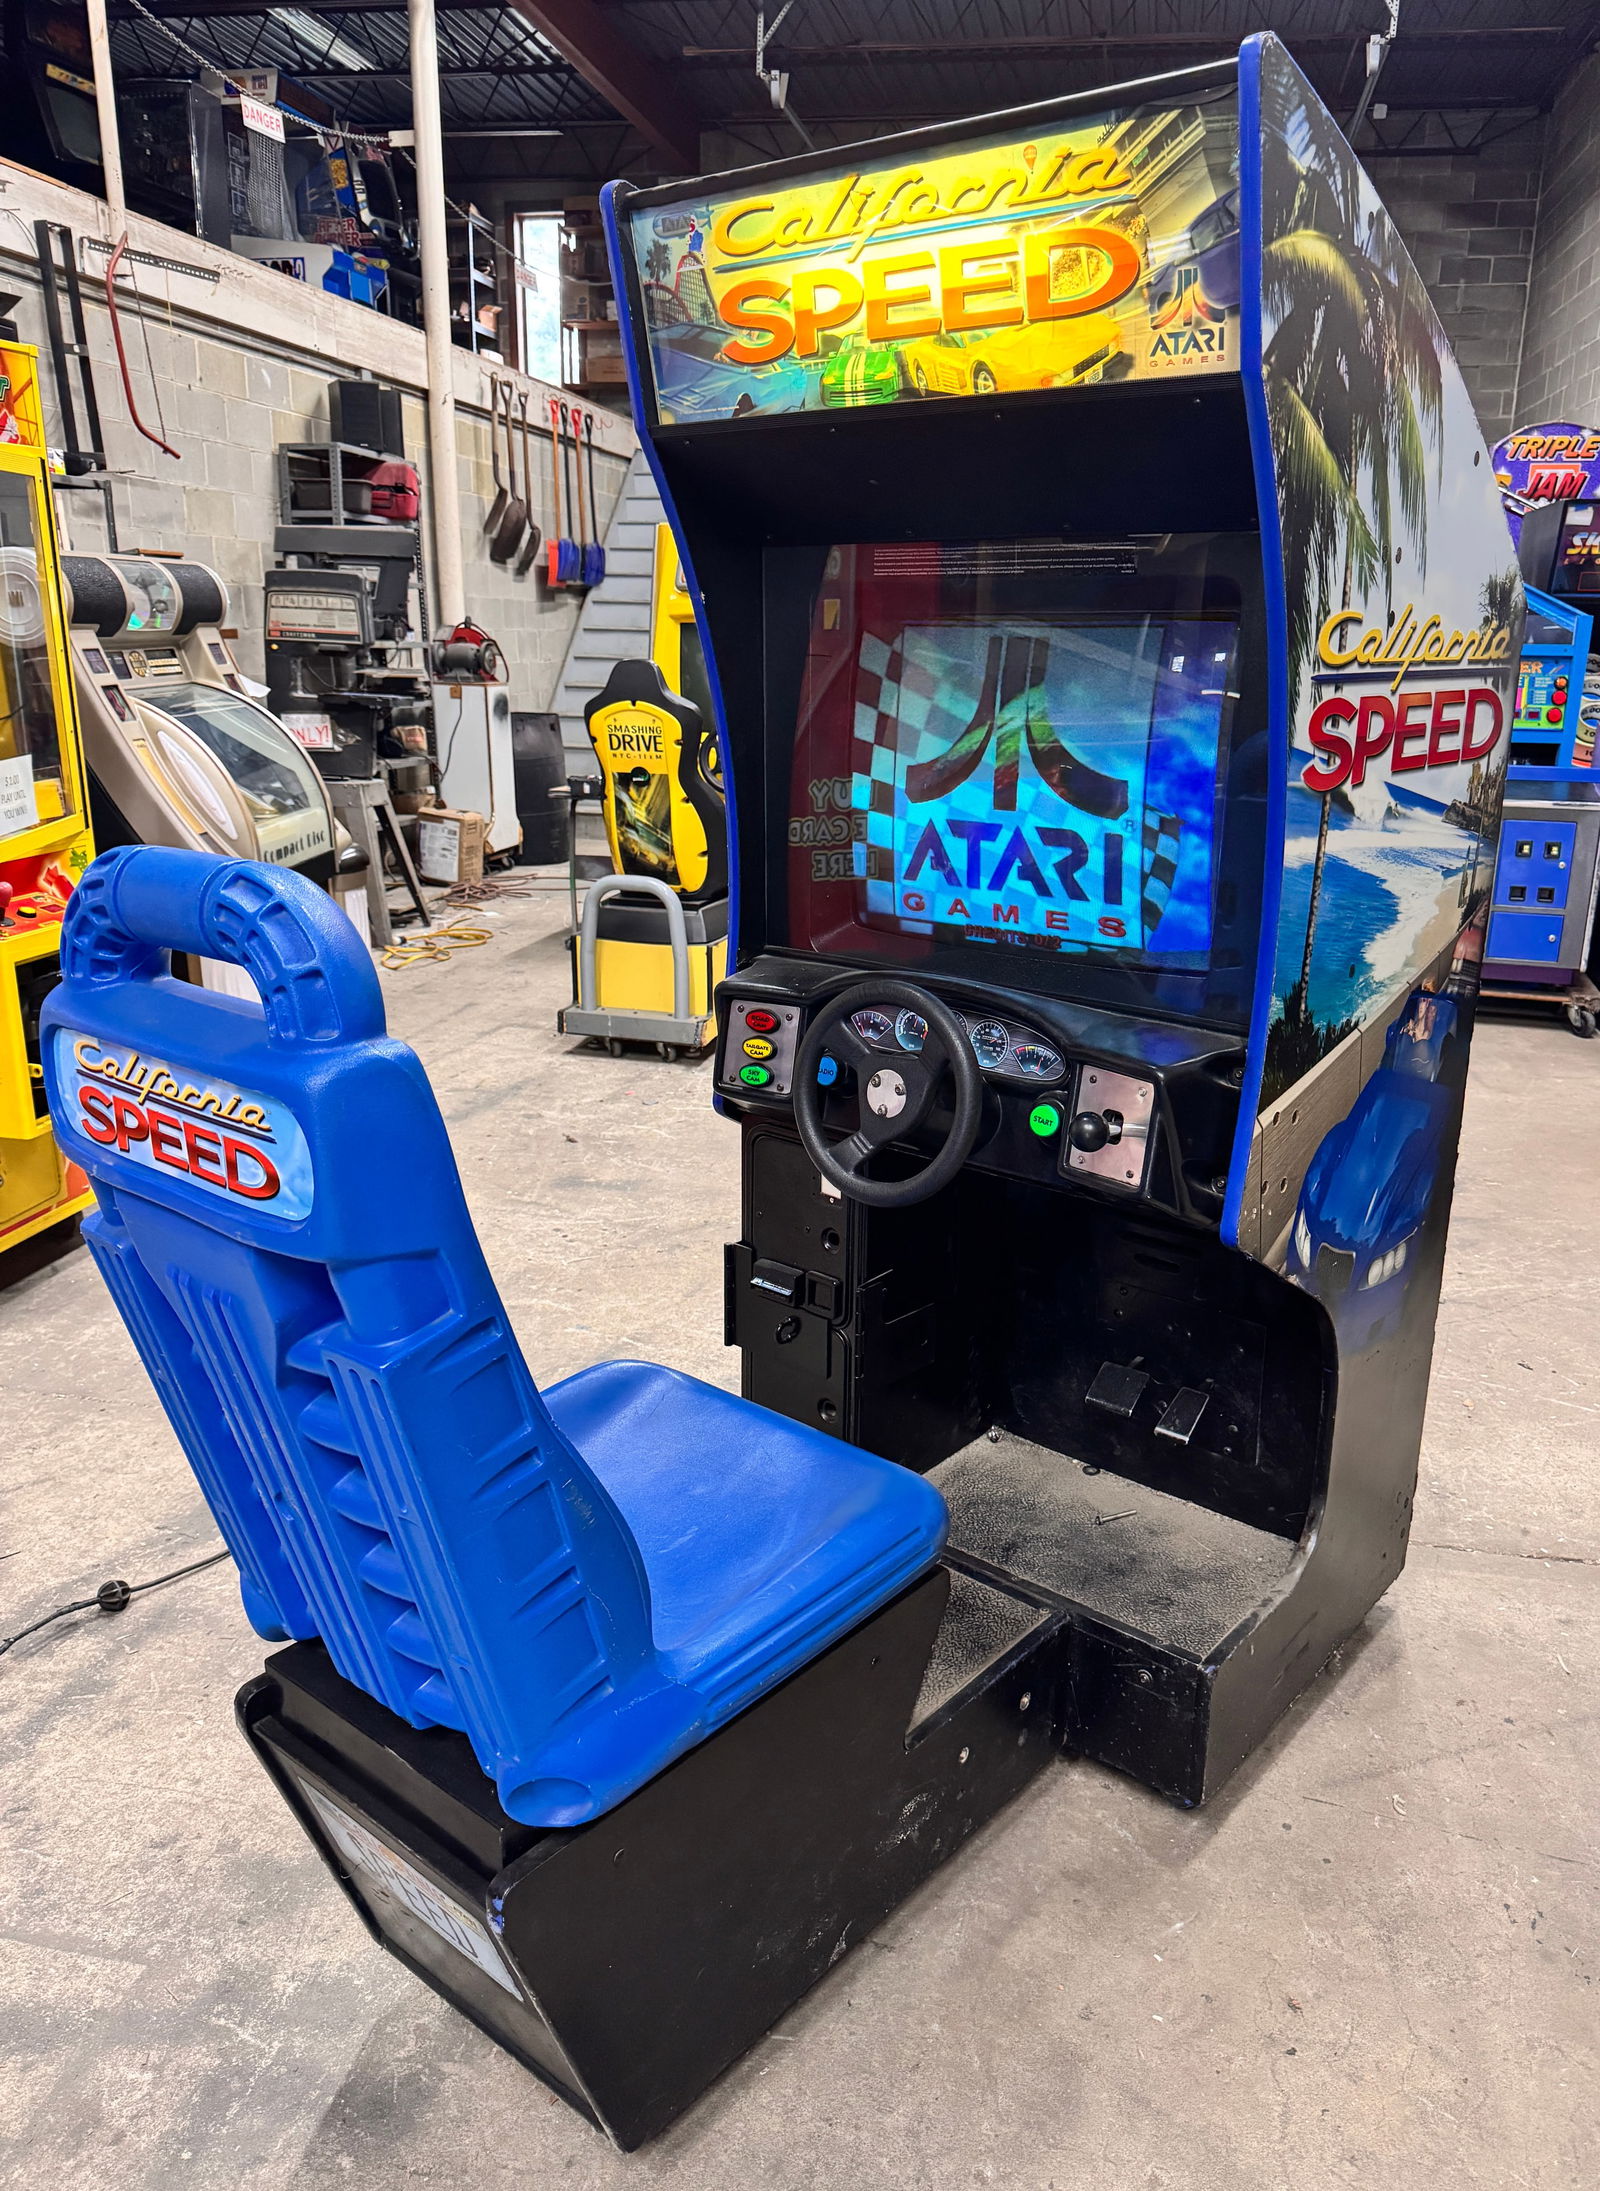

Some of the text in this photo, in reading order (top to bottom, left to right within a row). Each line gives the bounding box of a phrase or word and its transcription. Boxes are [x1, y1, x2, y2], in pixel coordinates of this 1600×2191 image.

[243, 104, 282, 132] DANGER
[712, 146, 1131, 264] California
[719, 226, 1140, 365] SPEED
[1149, 327, 1225, 358] ATARI
[1149, 354, 1225, 368] GAMES
[1507, 435, 1600, 461] TRIPLE
[1516, 472, 1590, 502] JAM
[1318, 603, 1512, 693] California
[290, 725, 329, 743] NLY!
[607, 724, 662, 735] SMASHING
[608, 734, 663, 752] DRIVE
[1302, 688, 1504, 792] SPEED
[903, 818, 1123, 905] ATARI
[902, 892, 1127, 938] GAMES
[751, 1014, 769, 1023] ROAD
[746, 1043, 768, 1051] TAILGATE
[73, 1041, 273, 1132] California
[748, 1069, 760, 1077] SKY
[820, 1069, 834, 1077] ADIO
[1033, 1114, 1054, 1127] START
[78, 1085, 281, 1201] SPEED
